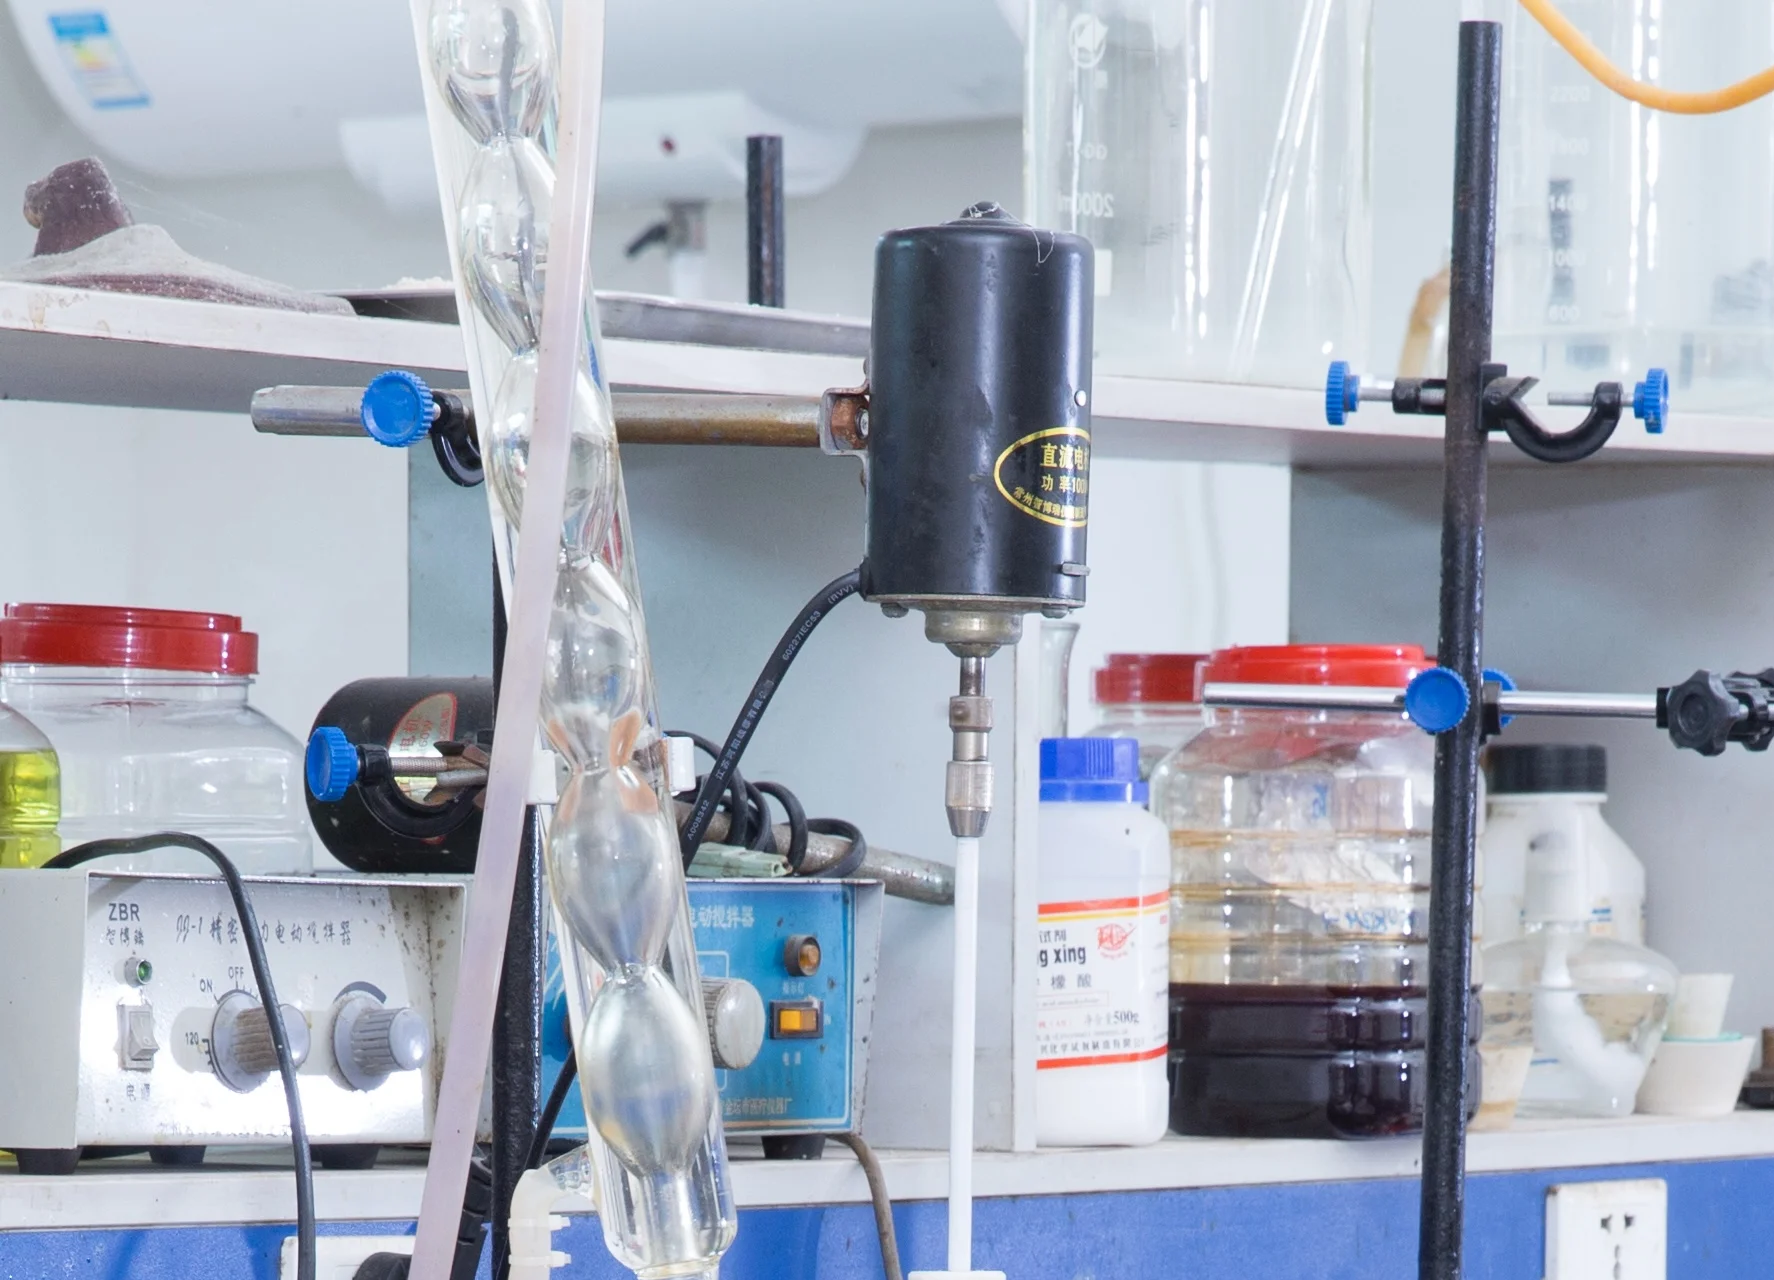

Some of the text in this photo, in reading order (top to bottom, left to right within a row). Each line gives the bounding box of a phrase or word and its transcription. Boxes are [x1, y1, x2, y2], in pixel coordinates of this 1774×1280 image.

[108, 903, 140, 921] ZBR
[1054, 944, 1087, 965] xing
[228, 966, 245, 979] OFF
[200, 978, 213, 993] ON
[1037, 972, 1092, 990] 檬酸
[185, 1032, 199, 1046] 120
